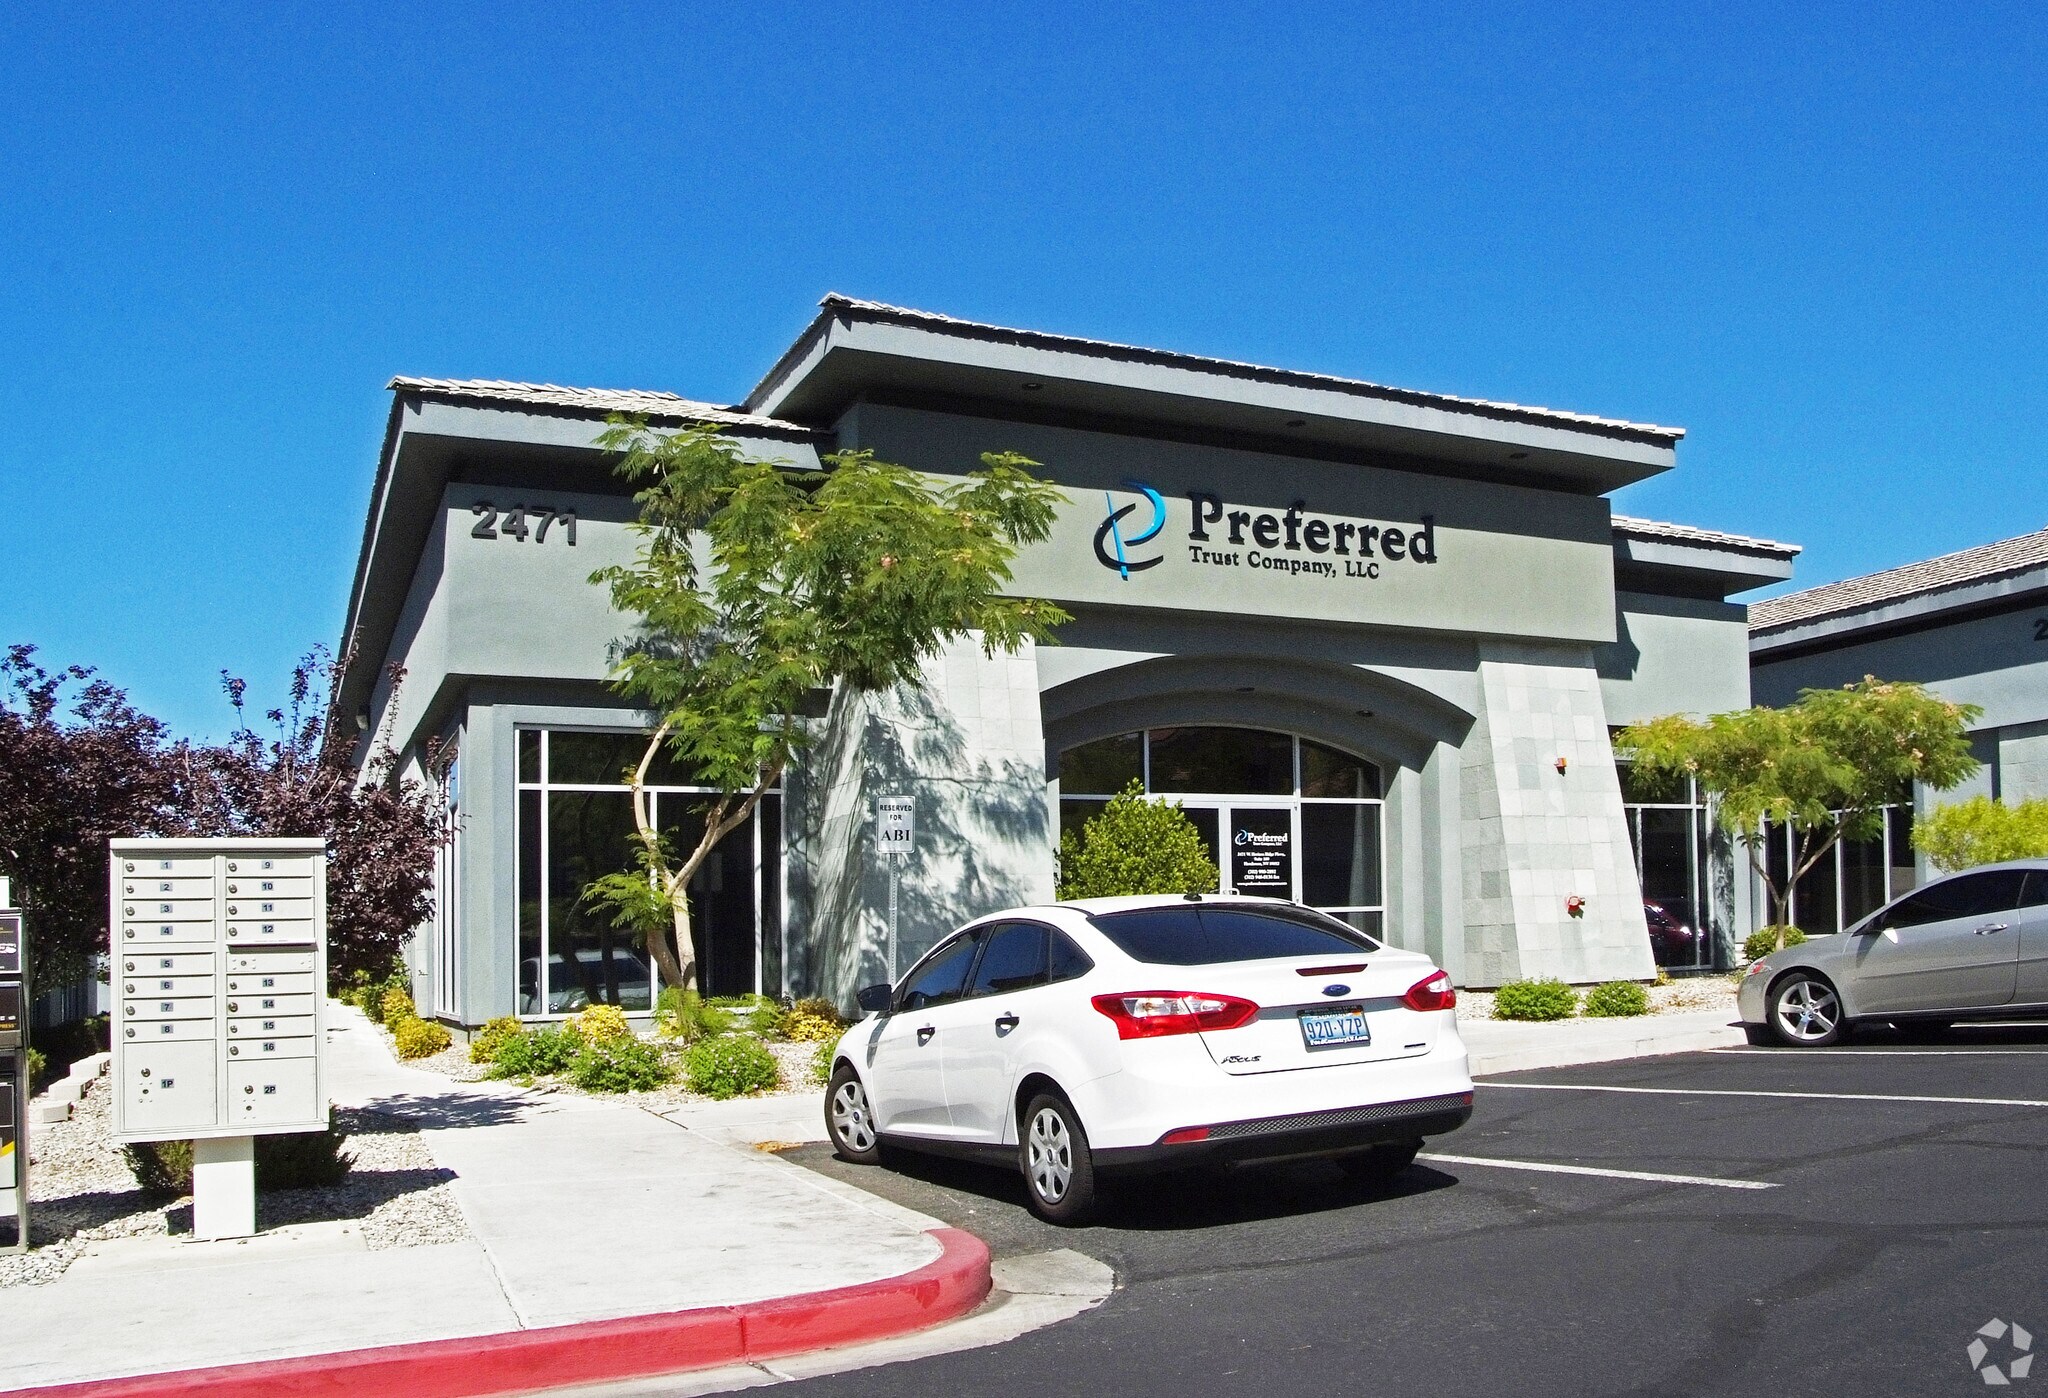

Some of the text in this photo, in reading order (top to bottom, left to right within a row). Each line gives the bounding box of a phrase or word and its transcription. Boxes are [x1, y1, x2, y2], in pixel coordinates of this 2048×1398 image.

[471, 501, 577, 546] 2471
[1187, 491, 1437, 564] Preferred
[1189, 546, 1380, 580] Trust Company, LLC
[879, 804, 913, 812] RESERVED
[881, 829, 911, 841] ABI
[1247, 832, 1288, 842] Preferred
[164, 861, 169, 869] 1
[264, 861, 271, 869] 9
[163, 883, 170, 891] 2
[262, 882, 273, 890] 10
[163, 905, 170, 913] 3
[263, 925, 274, 933] 12
[164, 960, 170, 968] 5
[163, 981, 170, 989] 6
[263, 979, 274, 987] 13
[164, 1003, 170, 1011] 7
[264, 1000, 274, 1008] 14
[164, 1025, 170, 1033] 8
[264, 1021, 274, 1029] 15
[264, 1043, 275, 1051] 16
[161, 1080, 174, 1088] 1P
[264, 1086, 276, 1094] 2P
